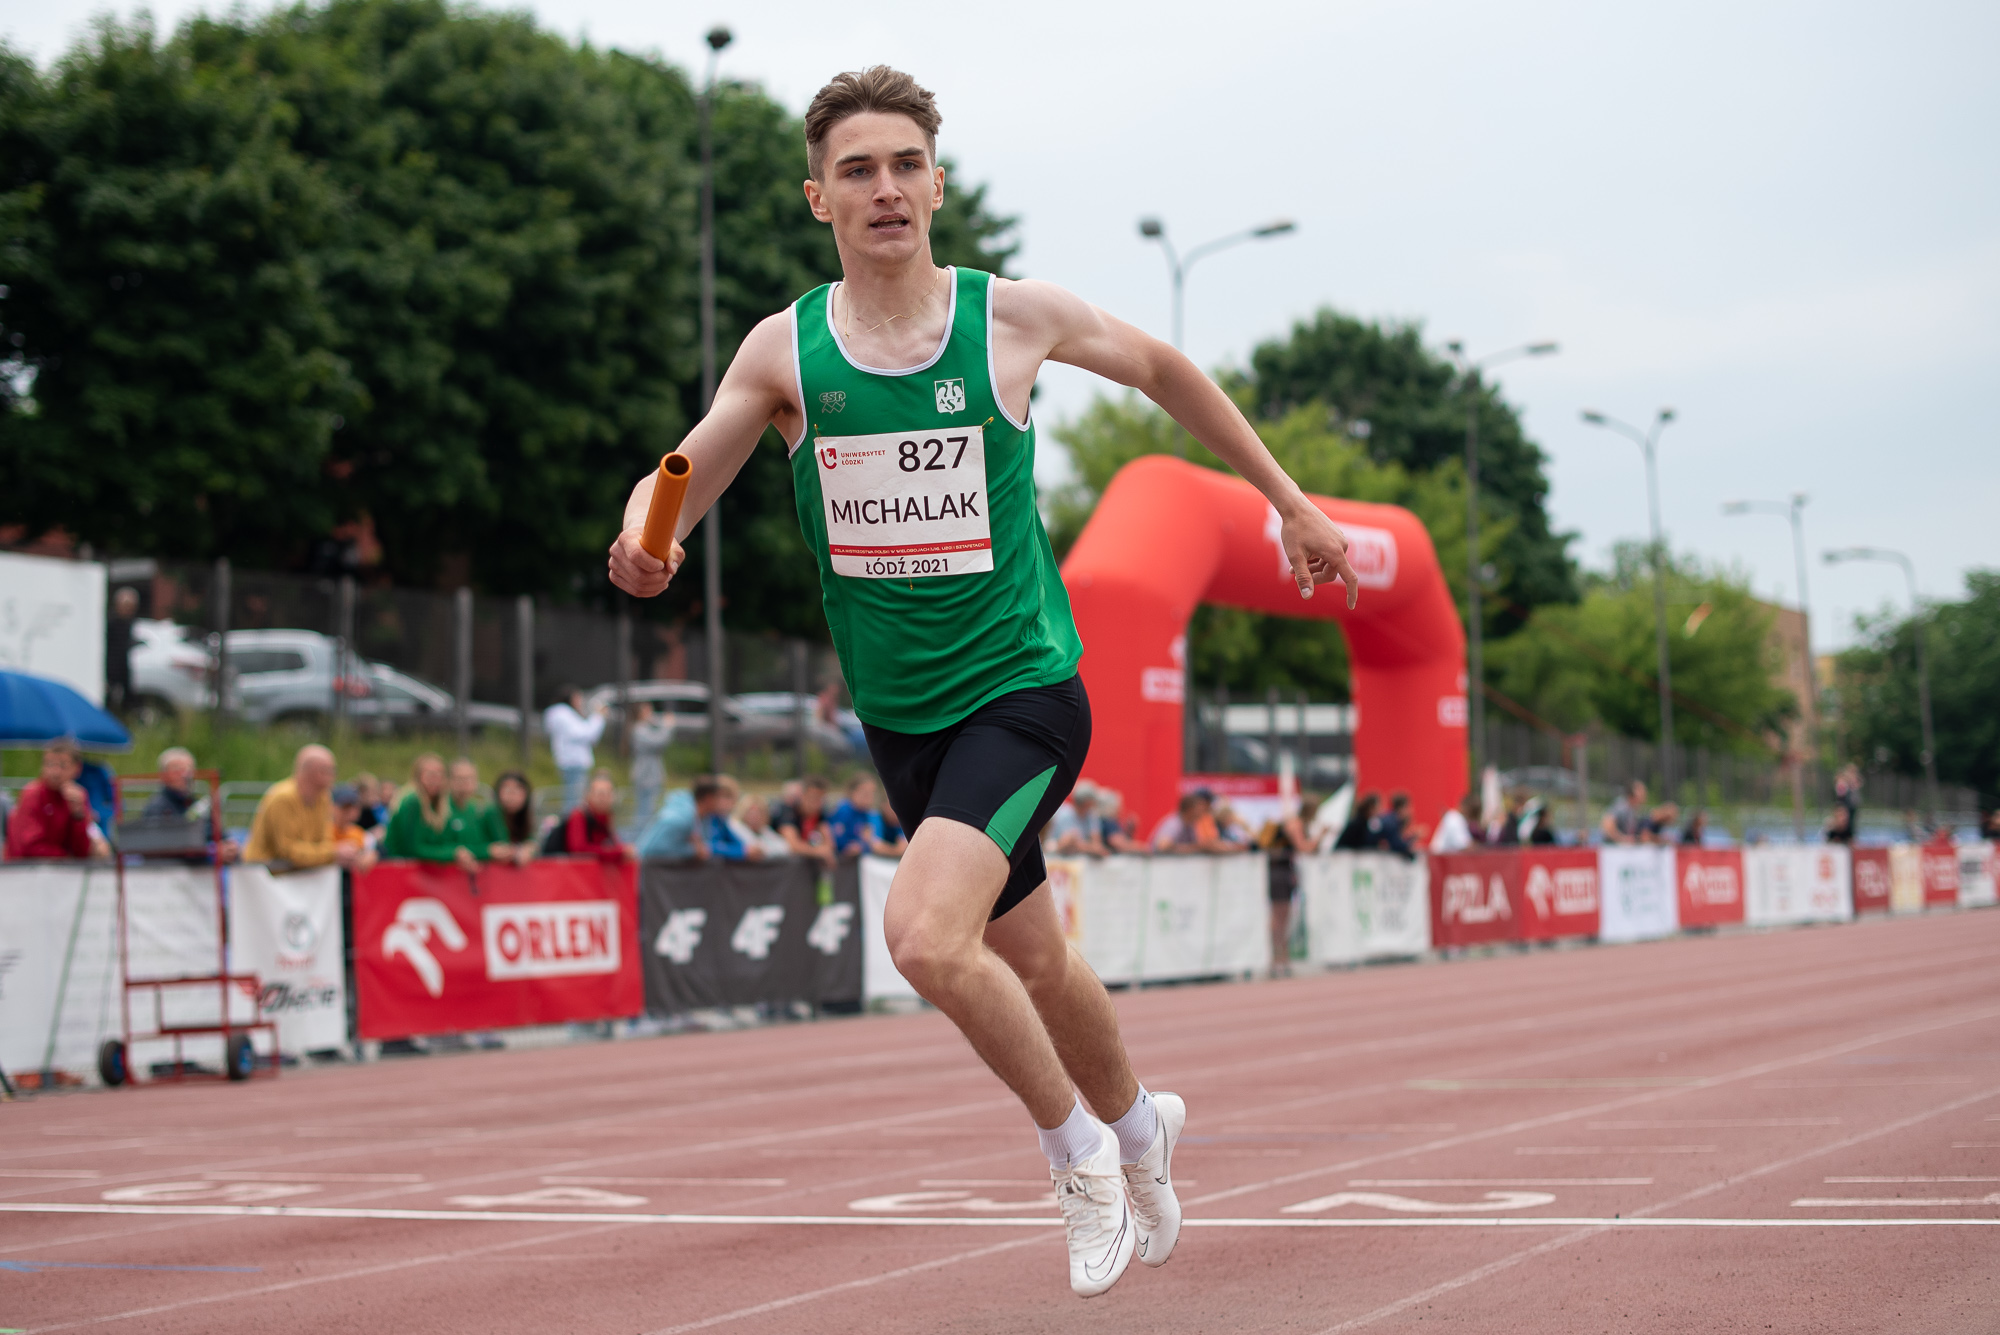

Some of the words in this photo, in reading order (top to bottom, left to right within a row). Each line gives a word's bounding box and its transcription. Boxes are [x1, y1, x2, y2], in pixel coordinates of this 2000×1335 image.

[840, 449, 886, 458] UNIWERSYTET
[841, 458, 864, 466] ŁÓDZKI
[898, 436, 969, 473] 827
[830, 491, 980, 525] MICHALAK
[865, 557, 907, 575] ŁÓDŹ
[911, 558, 949, 574] 2021
[497, 916, 610, 963] ORLEN
[655, 907, 707, 964] 4F
[731, 904, 785, 960] 4F
[806, 902, 855, 955] 4F
